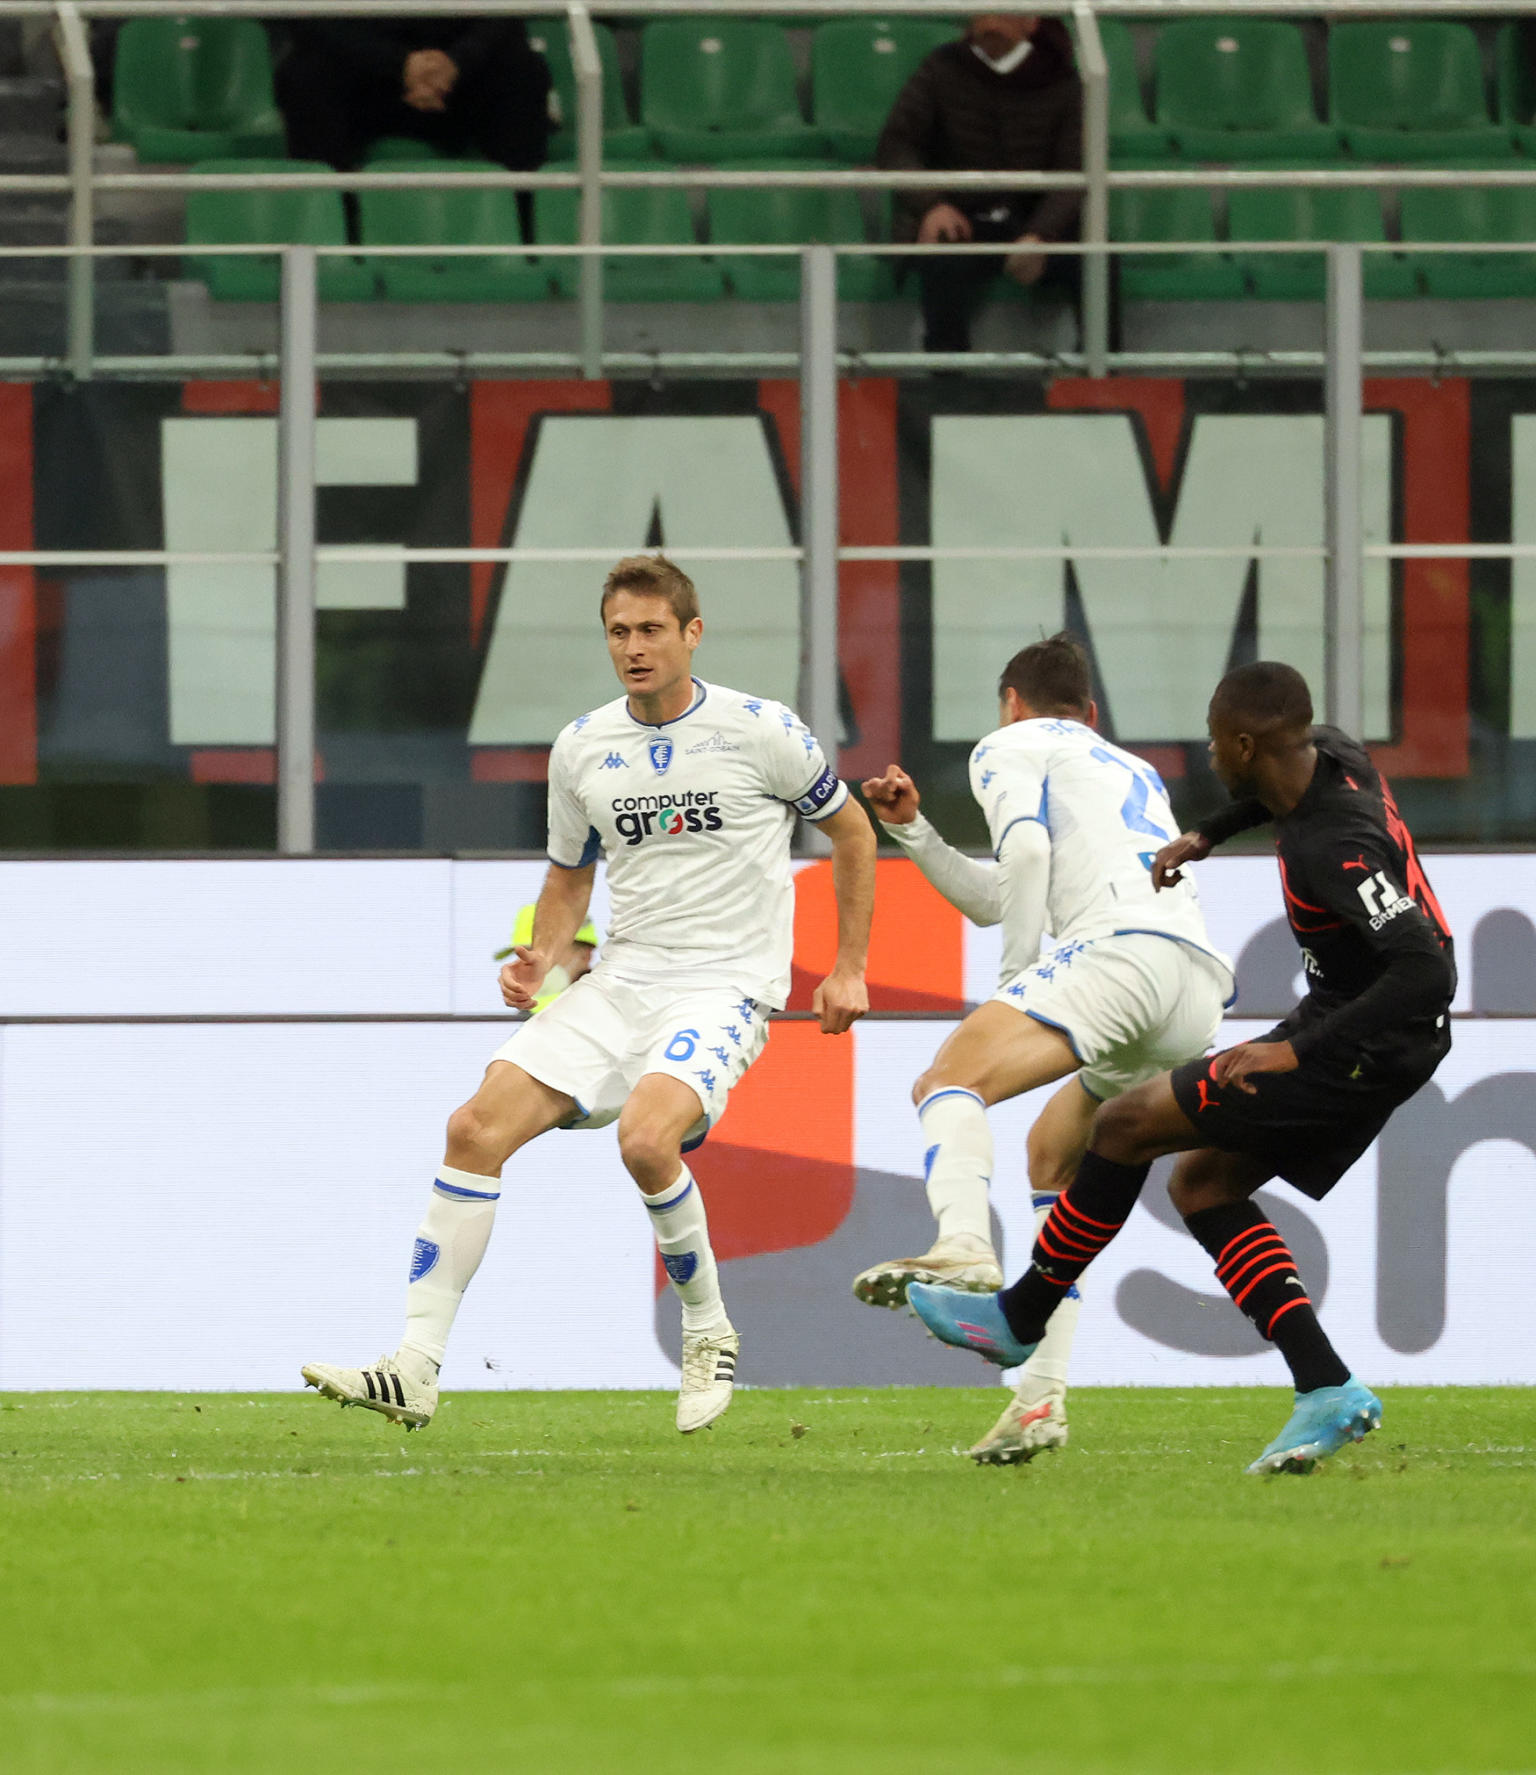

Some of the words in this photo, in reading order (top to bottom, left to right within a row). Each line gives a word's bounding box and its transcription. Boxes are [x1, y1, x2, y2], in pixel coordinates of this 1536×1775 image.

[160, 414, 1536, 746] FAM
[611, 790, 719, 812] computer
[1089, 746, 1171, 843] 2
[615, 806, 724, 846] gross
[664, 1028, 701, 1062] 6
